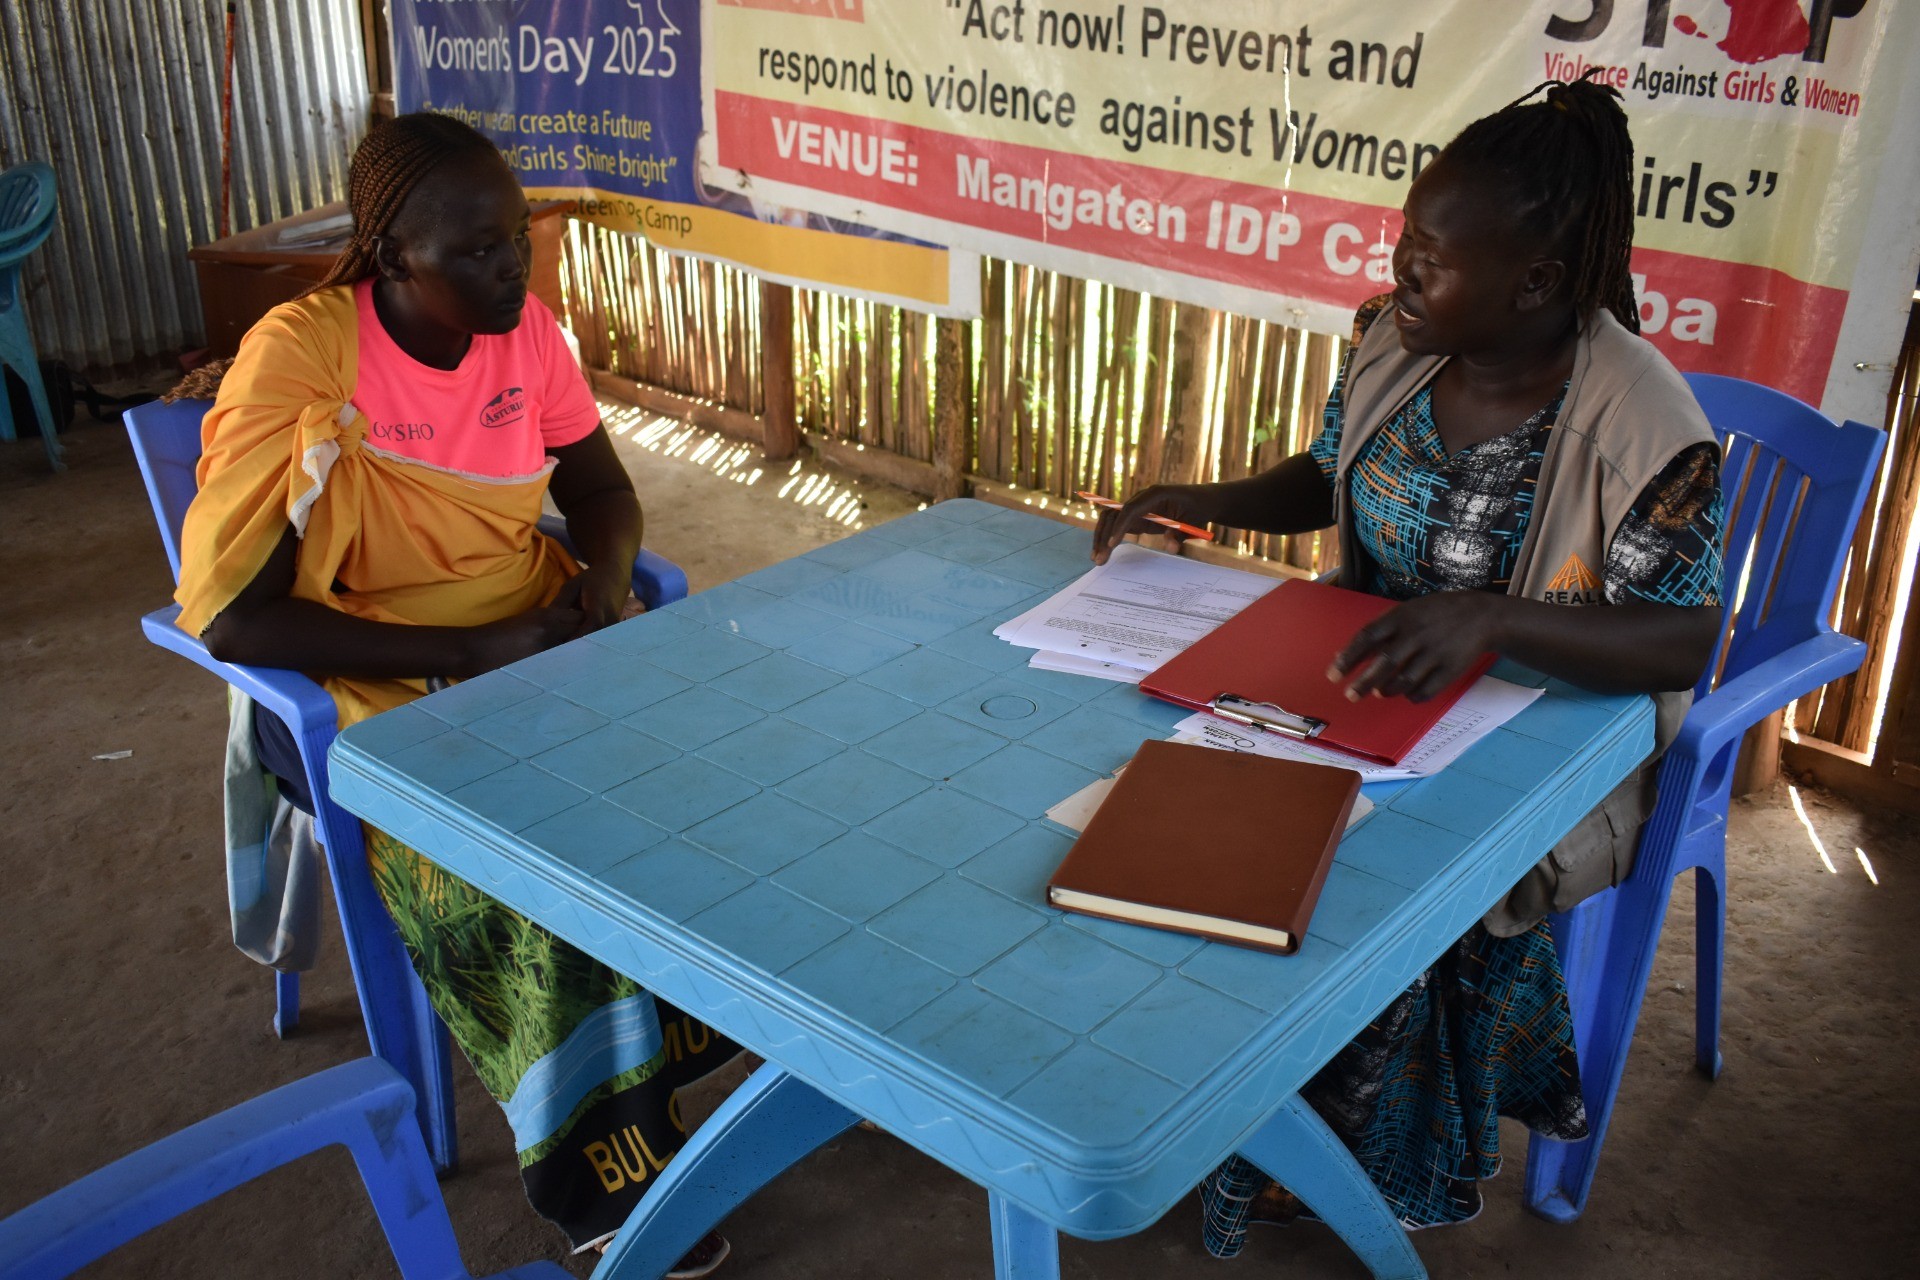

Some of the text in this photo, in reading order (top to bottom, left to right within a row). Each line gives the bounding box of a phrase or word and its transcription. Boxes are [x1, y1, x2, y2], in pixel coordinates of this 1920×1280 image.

[414, 24, 678, 86] Women's Day 2025
[1037, 4, 1125, 55] now!
[1142, 7, 1312, 78] Prevent
[1328, 32, 1425, 89] and
[1544, 52, 1861, 118] Violence Against Girls & Women
[519, 110, 587, 135] create
[591, 116, 599, 135] a
[602, 110, 652, 142] Future
[760, 47, 876, 96] respond
[885, 59, 914, 103] to
[924, 66, 1076, 128] violence
[1100, 96, 1254, 157] against
[1636, 157, 1779, 229] irls”
[574, 145, 616, 176] Shine
[771, 116, 919, 187] VENUE:
[956, 152, 1187, 244] Mangaten
[1206, 199, 1302, 262] IDP
[645, 205, 693, 239] Camp
